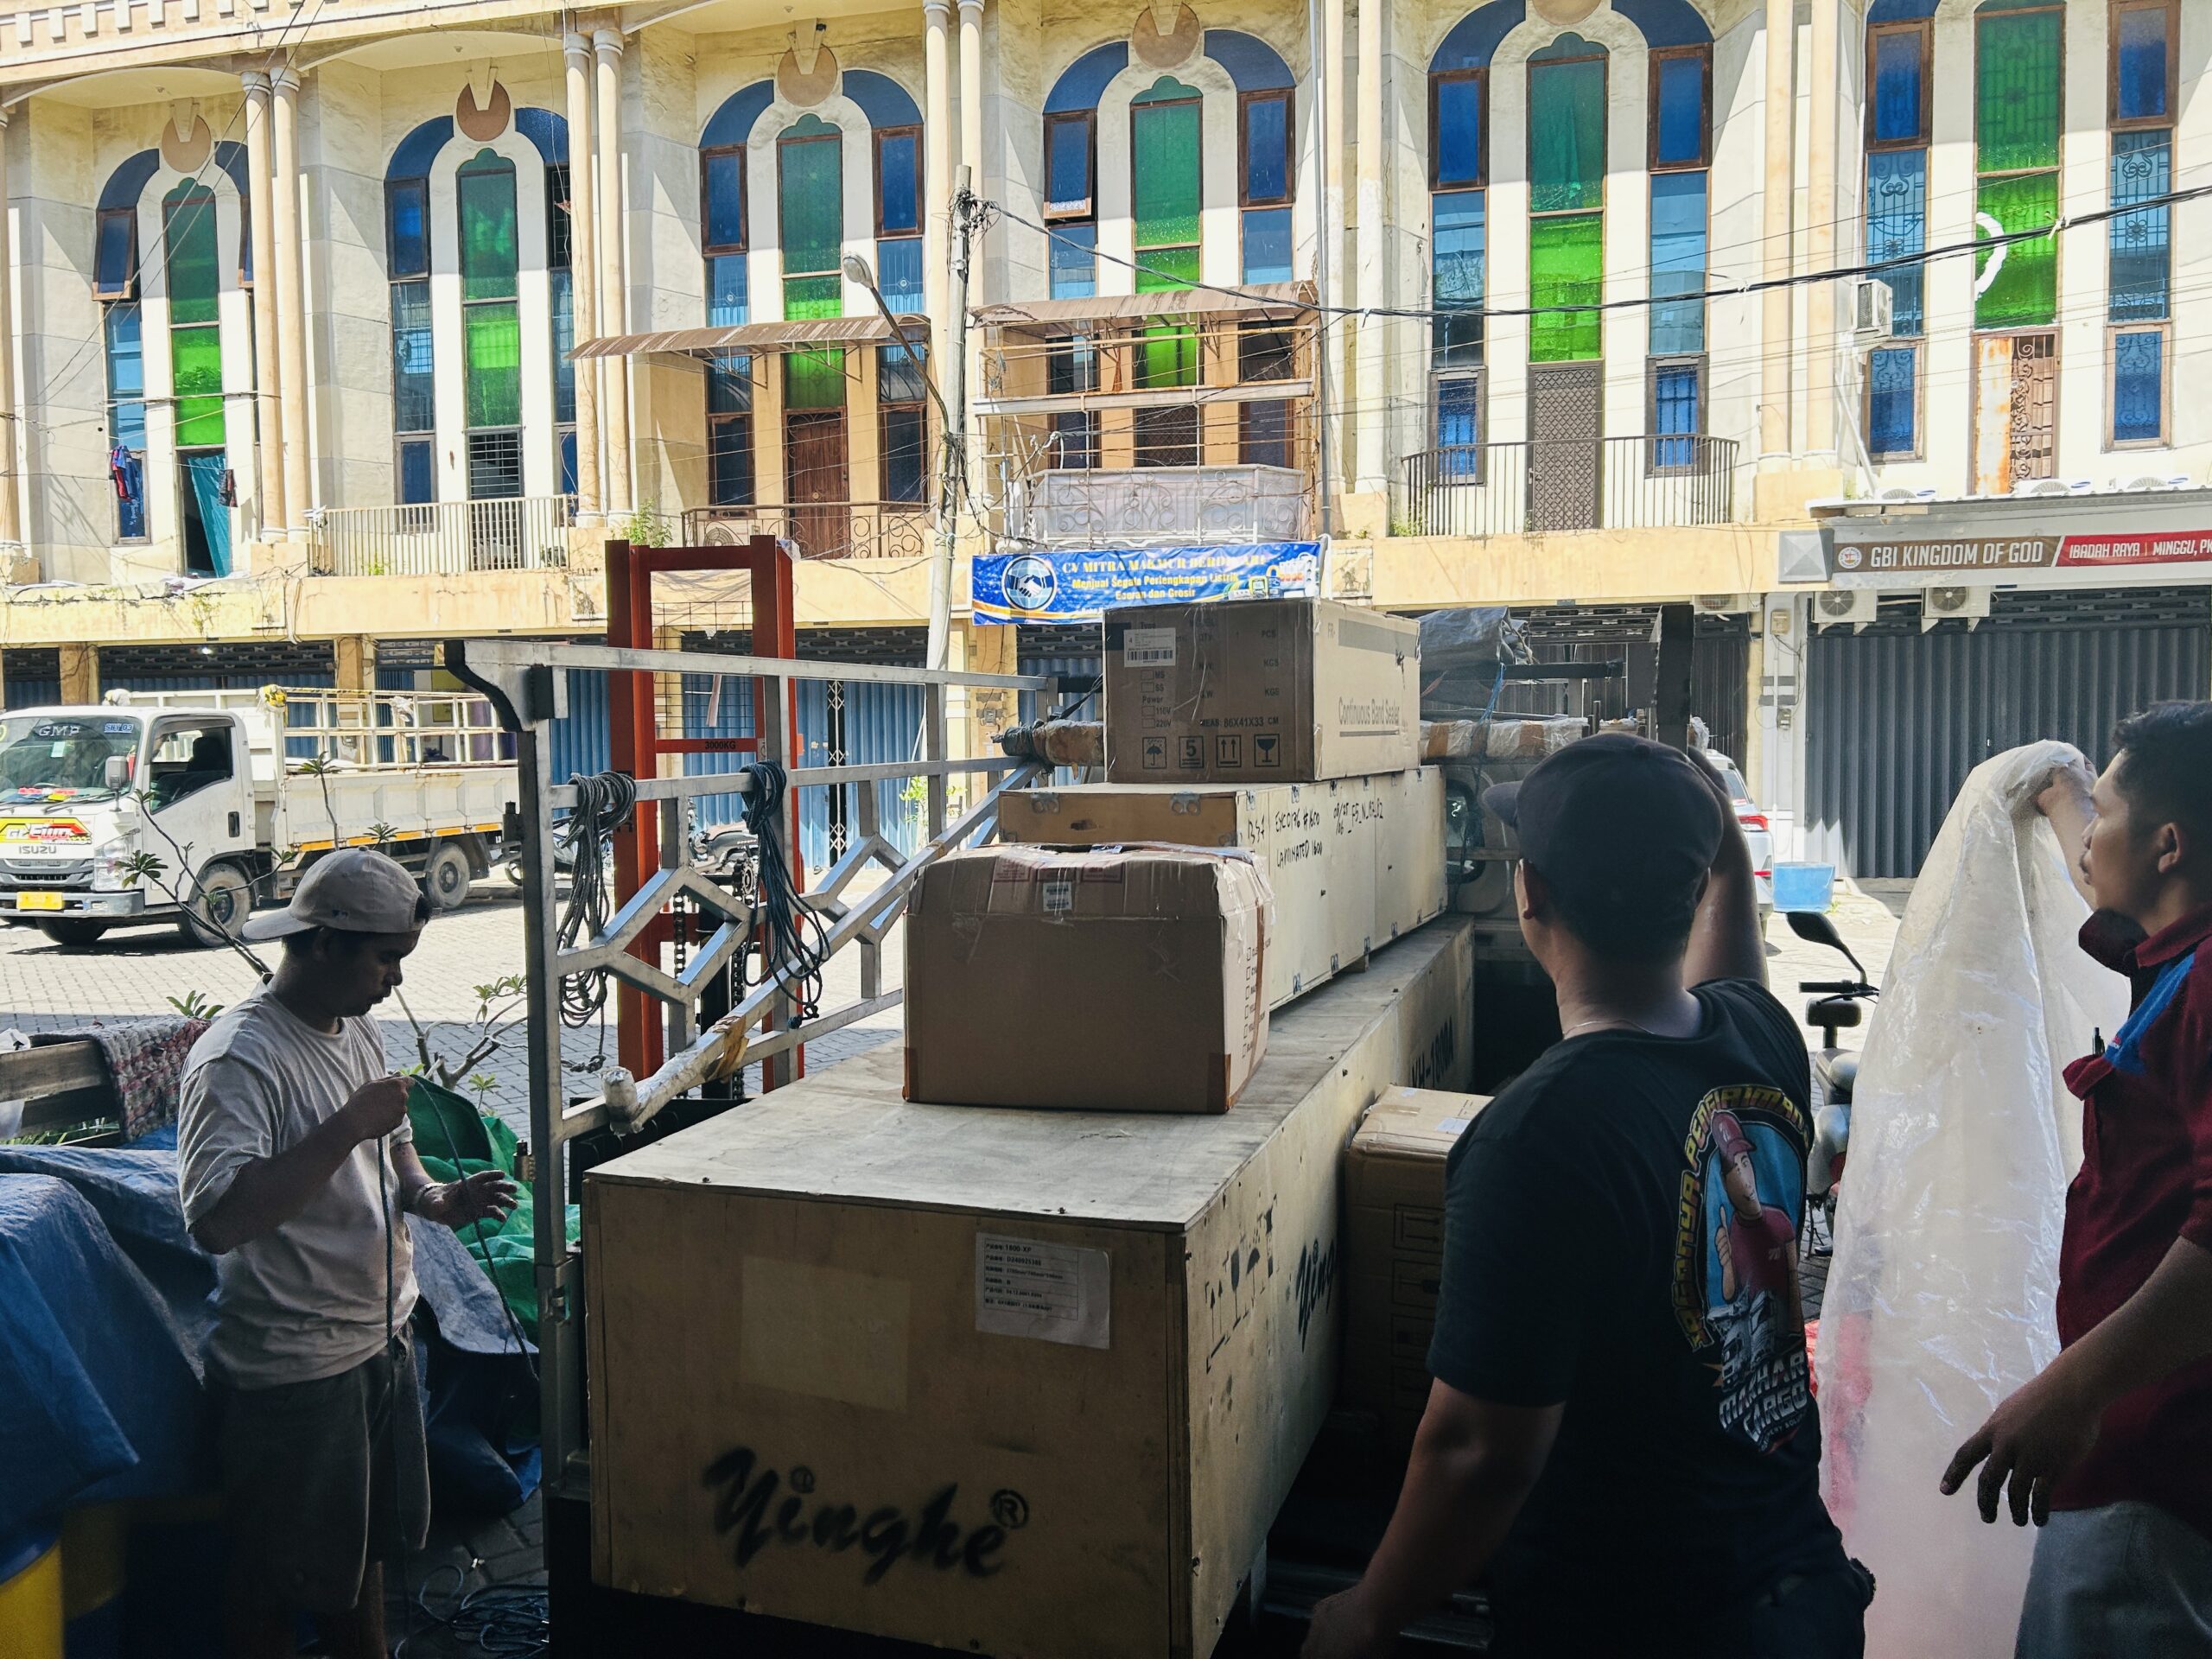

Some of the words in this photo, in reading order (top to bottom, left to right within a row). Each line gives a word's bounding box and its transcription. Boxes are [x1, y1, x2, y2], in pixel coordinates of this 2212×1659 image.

[1871, 546, 1898, 568] GBI
[1902, 543, 1978, 567] KINGDOM
[1983, 543, 2005, 564] OF
[2009, 541, 2044, 563] GOD
[2069, 543, 2110, 559] IBADAH
[2112, 543, 2140, 558] RAYA
[1062, 563, 1079, 574] CV
[1083, 560, 1125, 573] MITRA
[1072, 578, 1109, 589] Menjual
[1148, 588, 1166, 599] dan
[1142, 696, 1163, 704] Power
[1338, 696, 1370, 725] Continuous
[1371, 697, 1384, 725] Band
[39, 725, 80, 737] GMP
[705, 741, 736, 750] 3000KG
[1185, 740, 1198, 757] 5
[19, 846, 57, 855] ISUZU
[1743, 1380, 1808, 1443] CARGO
